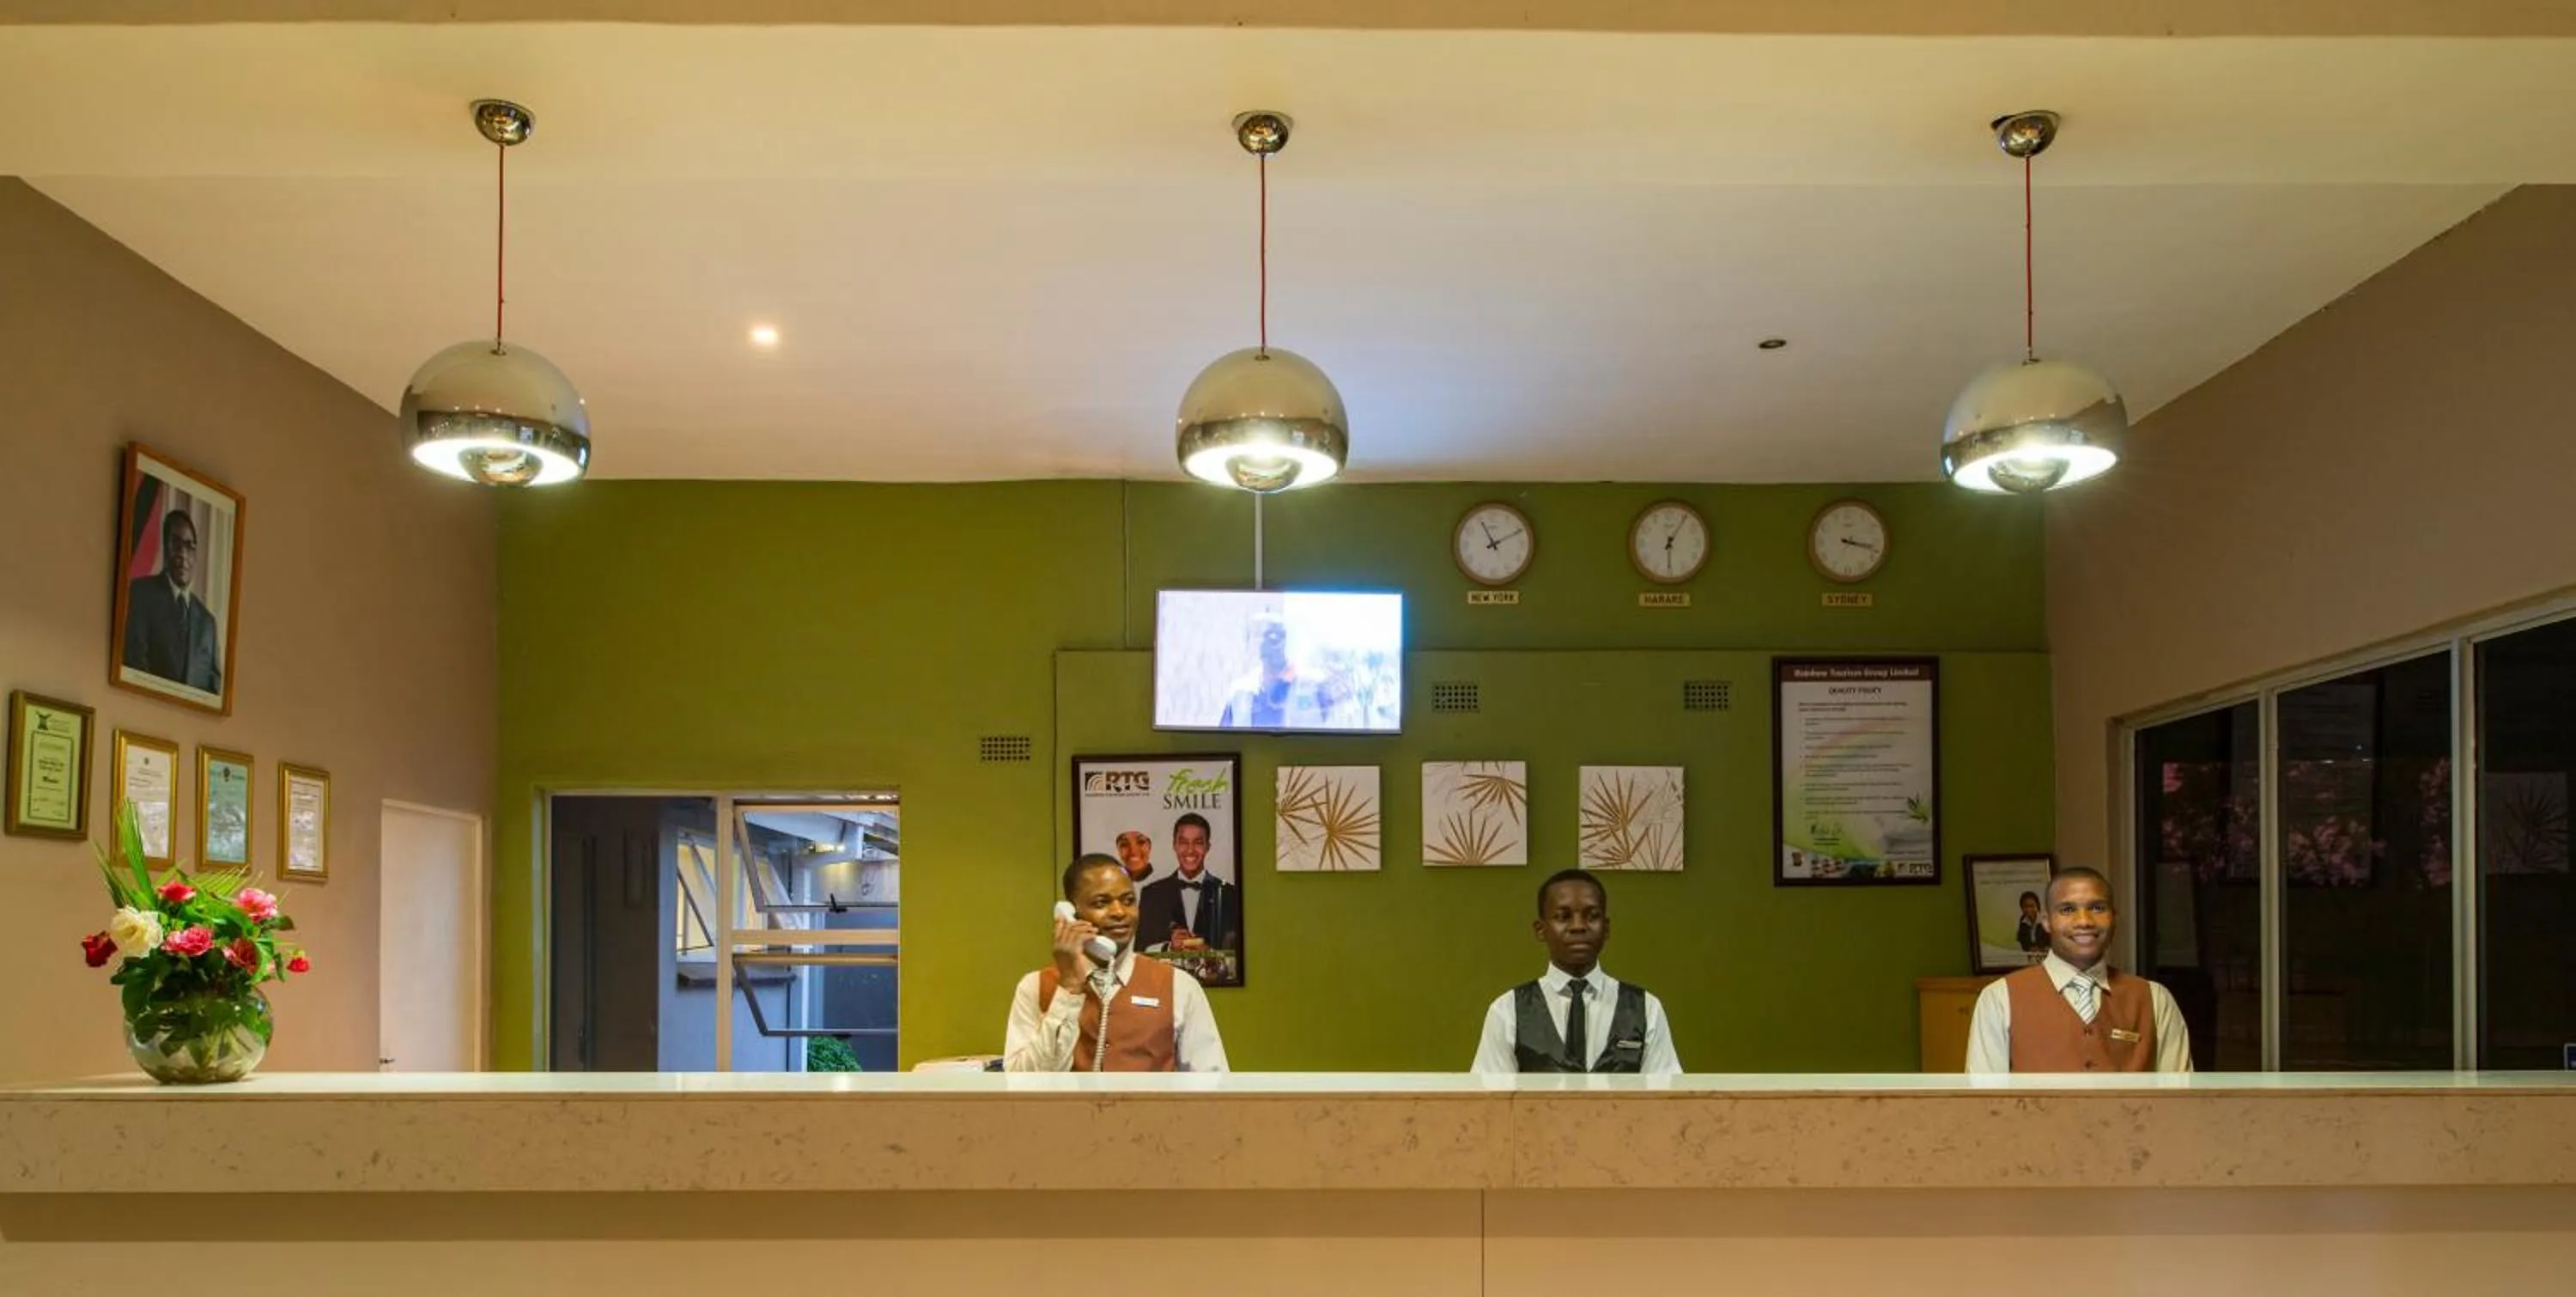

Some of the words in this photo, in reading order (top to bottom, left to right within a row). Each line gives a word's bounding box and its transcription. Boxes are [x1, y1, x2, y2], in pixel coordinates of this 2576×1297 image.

[1471, 592, 1490, 602] NEW
[1492, 592, 1514, 602] YORK
[1644, 594, 1684, 604] HARARE
[1826, 594, 1868, 604] SYDNEY
[1890, 666, 1919, 677] Limited
[1829, 686, 1856, 695] QUALITY
[1106, 770, 1150, 792] RTG
[1163, 794, 1222, 810] SMILE
